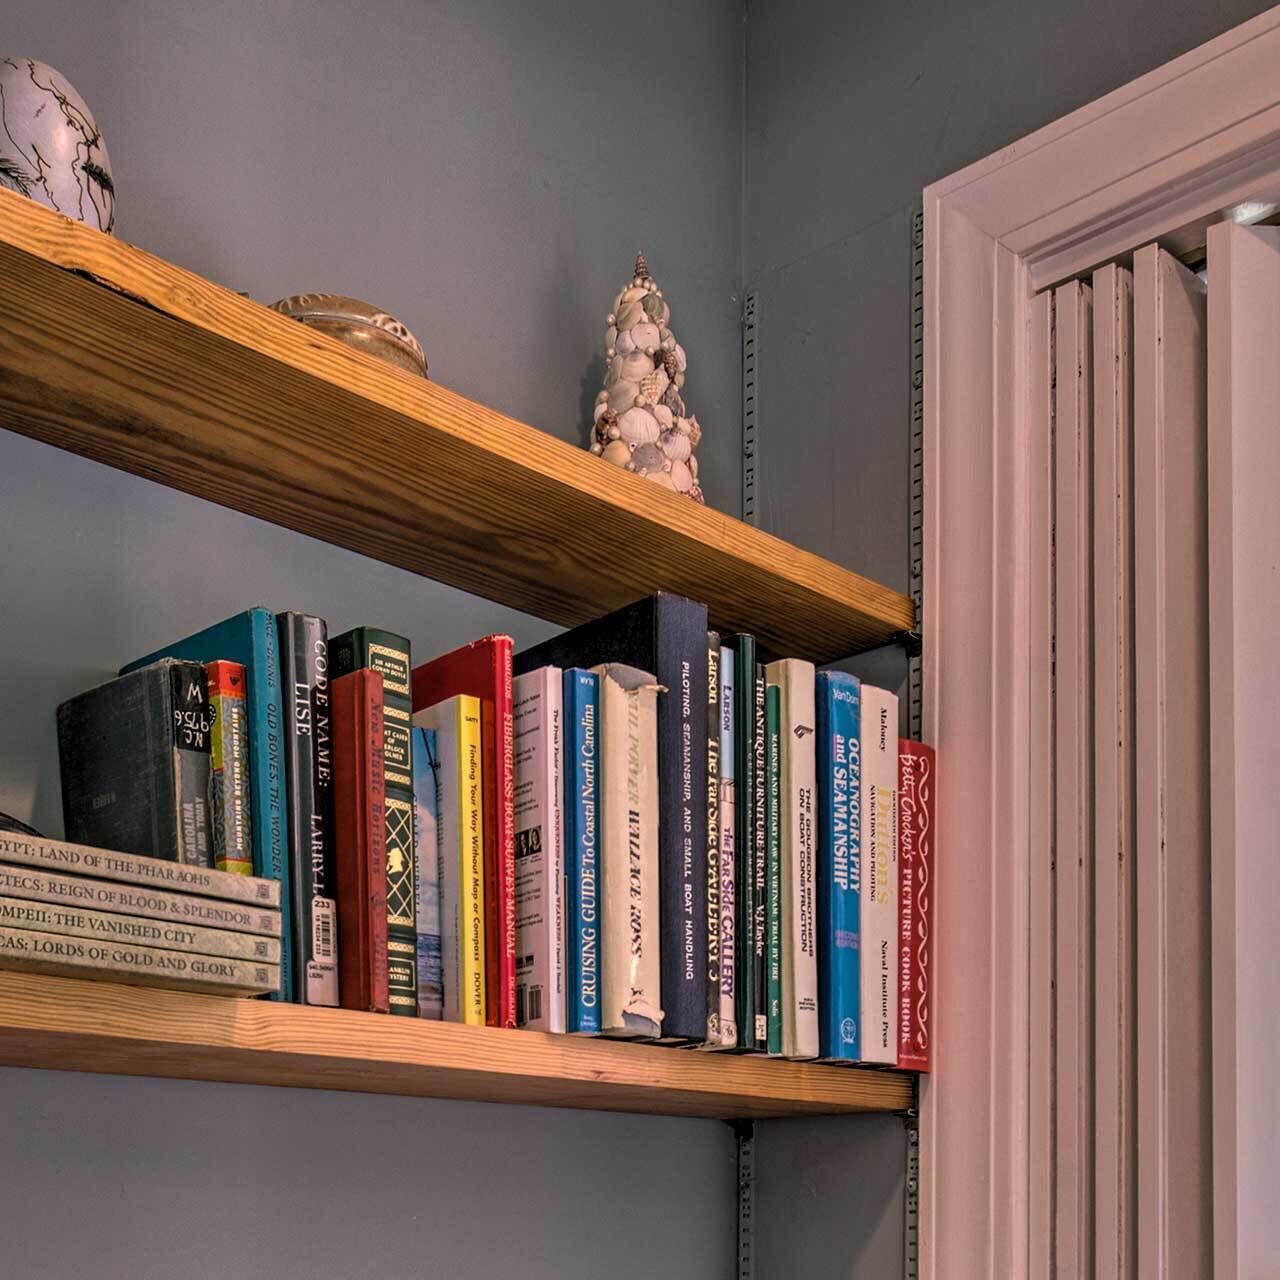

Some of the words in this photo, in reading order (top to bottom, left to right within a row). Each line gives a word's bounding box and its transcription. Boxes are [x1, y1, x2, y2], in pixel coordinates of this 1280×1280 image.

[708, 648, 719, 704] Larson
[755, 678, 763, 700] THE
[295, 682, 311, 736] LISE
[582, 704, 594, 757] Carolina
[879, 707, 888, 751] Maloney
[708, 737, 719, 773] The
[755, 701, 764, 768] ANTIQUE
[836, 735, 847, 764] and
[582, 760, 594, 799] North
[708, 774, 718, 802] Far
[898, 754, 917, 794] Betty
[582, 799, 595, 846] Coastal
[684, 807, 692, 833] AND
[708, 802, 719, 847] Side
[756, 772, 765, 847] FURNITURE
[834, 766, 848, 891] SEAMANSHIP
[848, 737, 861, 894] OCEANOGRAPHY
[899, 797, 916, 861] Crocker's
[40, 846, 80, 863] LAND
[83, 854, 101, 868] OF
[105, 858, 134, 873] THE
[137, 864, 210, 886] PHARAOHS
[583, 849, 595, 864] To
[684, 837, 693, 878] SMALL
[756, 849, 764, 890] TRAIL
[47, 883, 94, 902] REIGN
[98, 890, 116, 903] OF
[119, 894, 167, 912] BLOOD
[183, 904, 251, 925] SPLENDOR
[581, 868, 596, 922] GUIDE
[684, 883, 692, 914] BOAT
[708, 848, 720, 963] GALLERY
[901, 868, 912, 941] PICTURE
[54, 913, 85, 928] THE
[88, 919, 161, 940] VANISHED
[164, 930, 196, 945] CITY
[685, 920, 694, 980] HANDLING
[33, 940, 84, 957] LORDS
[88, 947, 108, 960] OF
[112, 950, 152, 966] GOLD
[156, 956, 187, 971] AND
[190, 961, 237, 977] GLORY
[582, 927, 596, 1007] CRUISING
[881, 940, 889, 970] Naval
[901, 946, 911, 992] COOK
[881, 974, 889, 1018] Institute
[901, 998, 911, 1044] BOOK
